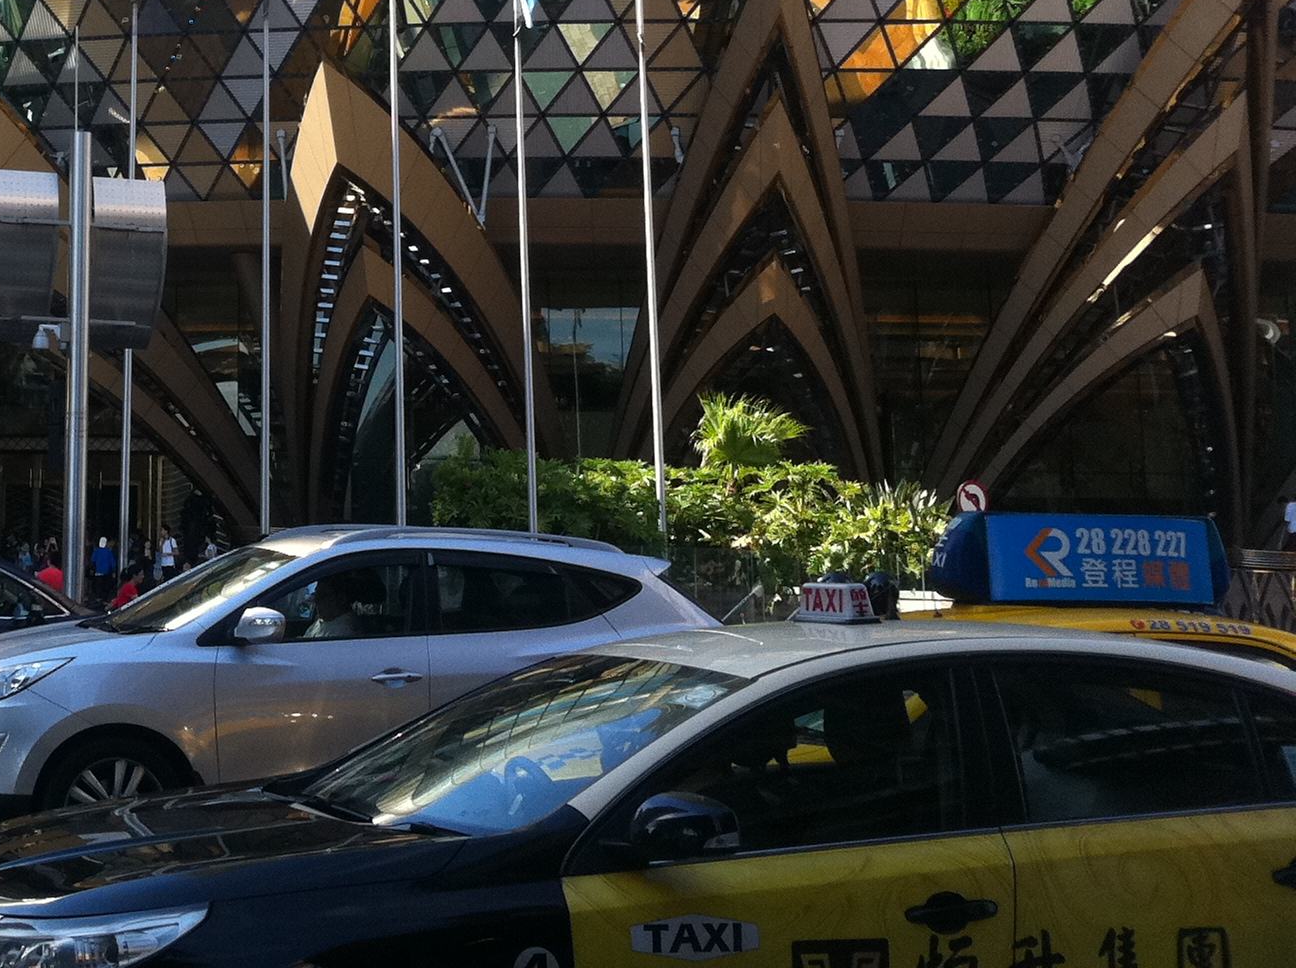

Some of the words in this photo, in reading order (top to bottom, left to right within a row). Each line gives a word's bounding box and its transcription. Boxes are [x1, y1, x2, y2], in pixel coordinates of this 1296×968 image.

[1075, 527, 1105, 555] 28
[1110, 528, 1151, 557] 228
[1153, 530, 1186, 558] 227
[803, 587, 844, 613] TAXI
[1149, 619, 1172, 630] 28
[1176, 619, 1212, 633] 519
[642, 922, 743, 953] TAXI
